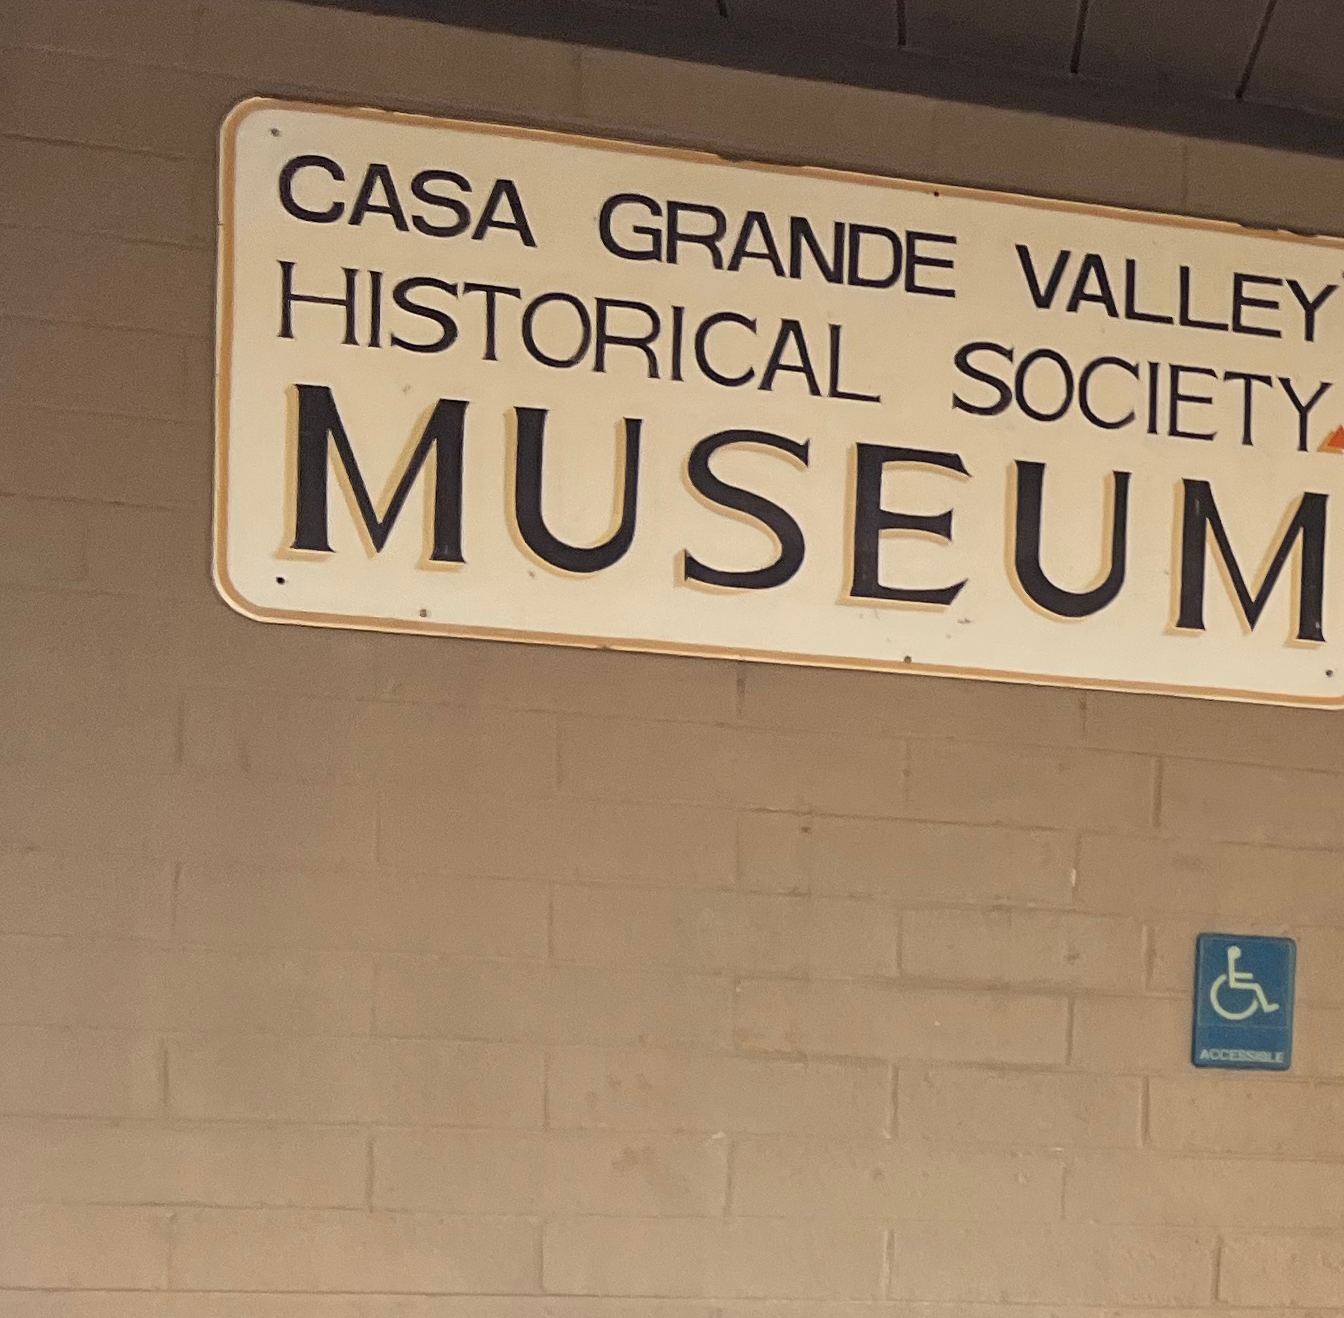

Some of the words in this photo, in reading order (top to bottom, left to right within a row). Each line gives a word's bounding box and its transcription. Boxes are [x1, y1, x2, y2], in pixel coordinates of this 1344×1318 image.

[278, 154, 538, 248] CASA
[599, 192, 957, 298] GRANDE
[1015, 243, 1339, 342] VALLEY
[276, 259, 881, 403] HISTORICAL
[952, 341, 1333, 452] SOCIETY
[282, 383, 1330, 645] MUSEUM
